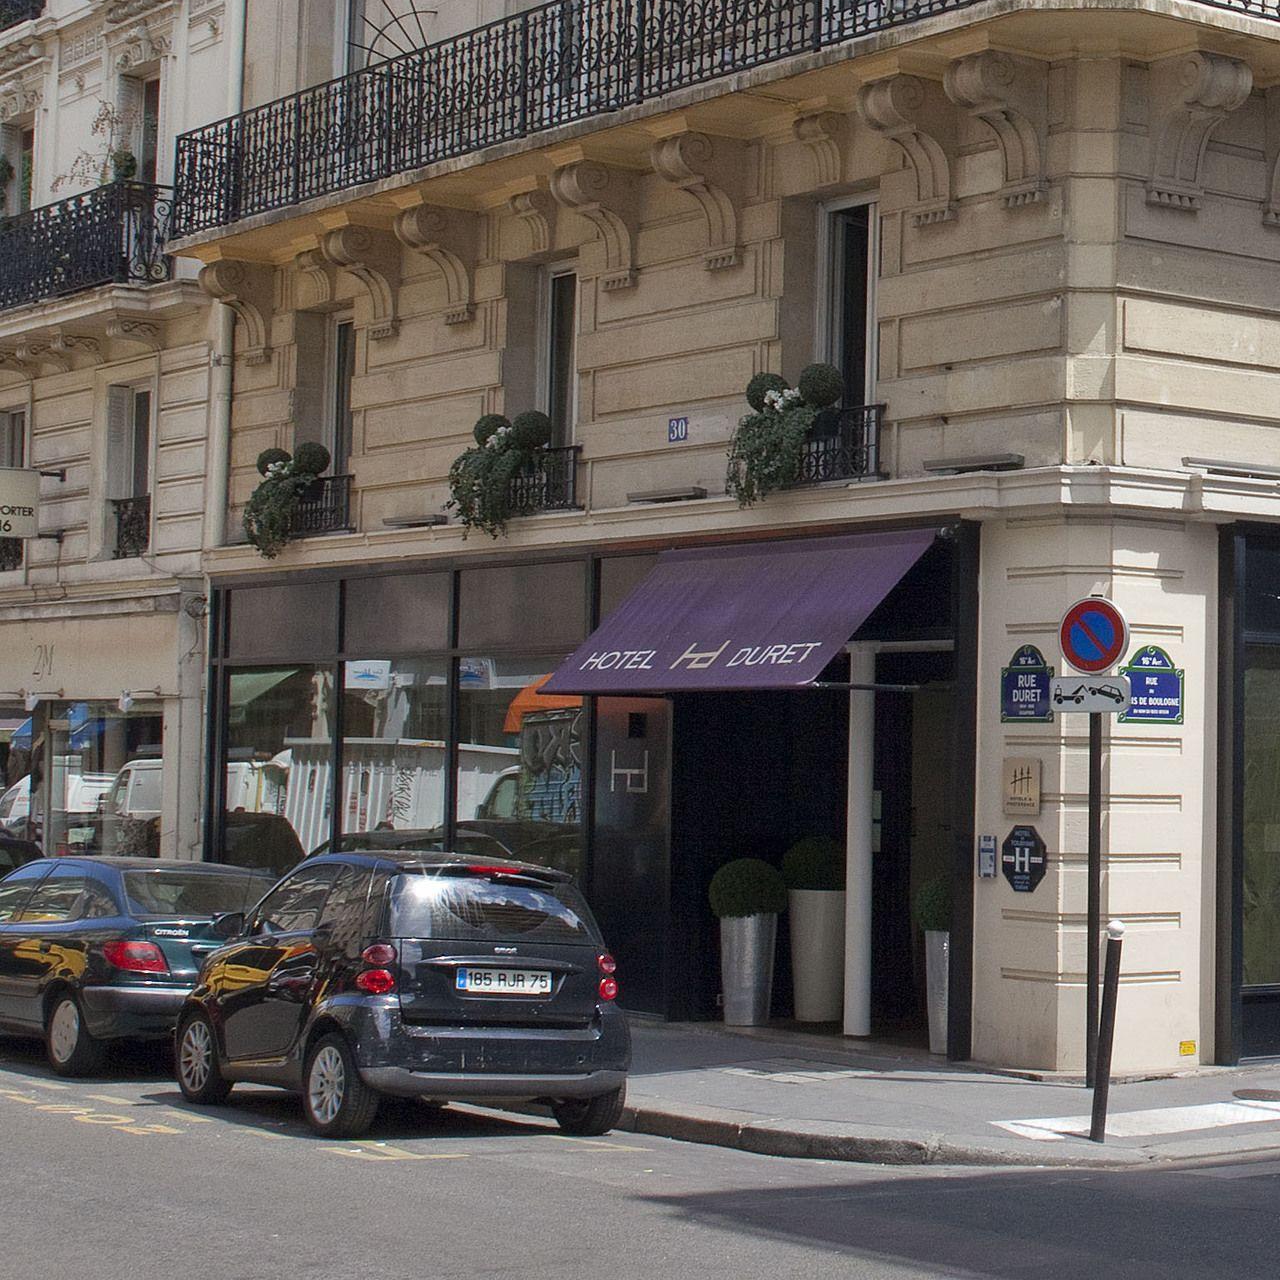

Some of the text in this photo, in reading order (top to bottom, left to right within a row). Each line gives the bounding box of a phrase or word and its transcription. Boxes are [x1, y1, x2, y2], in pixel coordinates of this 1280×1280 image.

[670, 419, 686, 440] 30
[0, 505, 34, 517] ORTER
[579, 649, 658, 671] HOTEL
[726, 642, 822, 669] DURET
[1018, 675, 1037, 687] RUE
[1145, 677, 1158, 685] RUE
[1012, 689, 1041, 702] DURET
[1139, 697, 1147, 705] DE
[1149, 697, 1179, 706] BOULOGNE
[1015, 847, 1030, 873] H
[498, 973, 525, 987] RJR
[531, 974, 548, 988] 75
